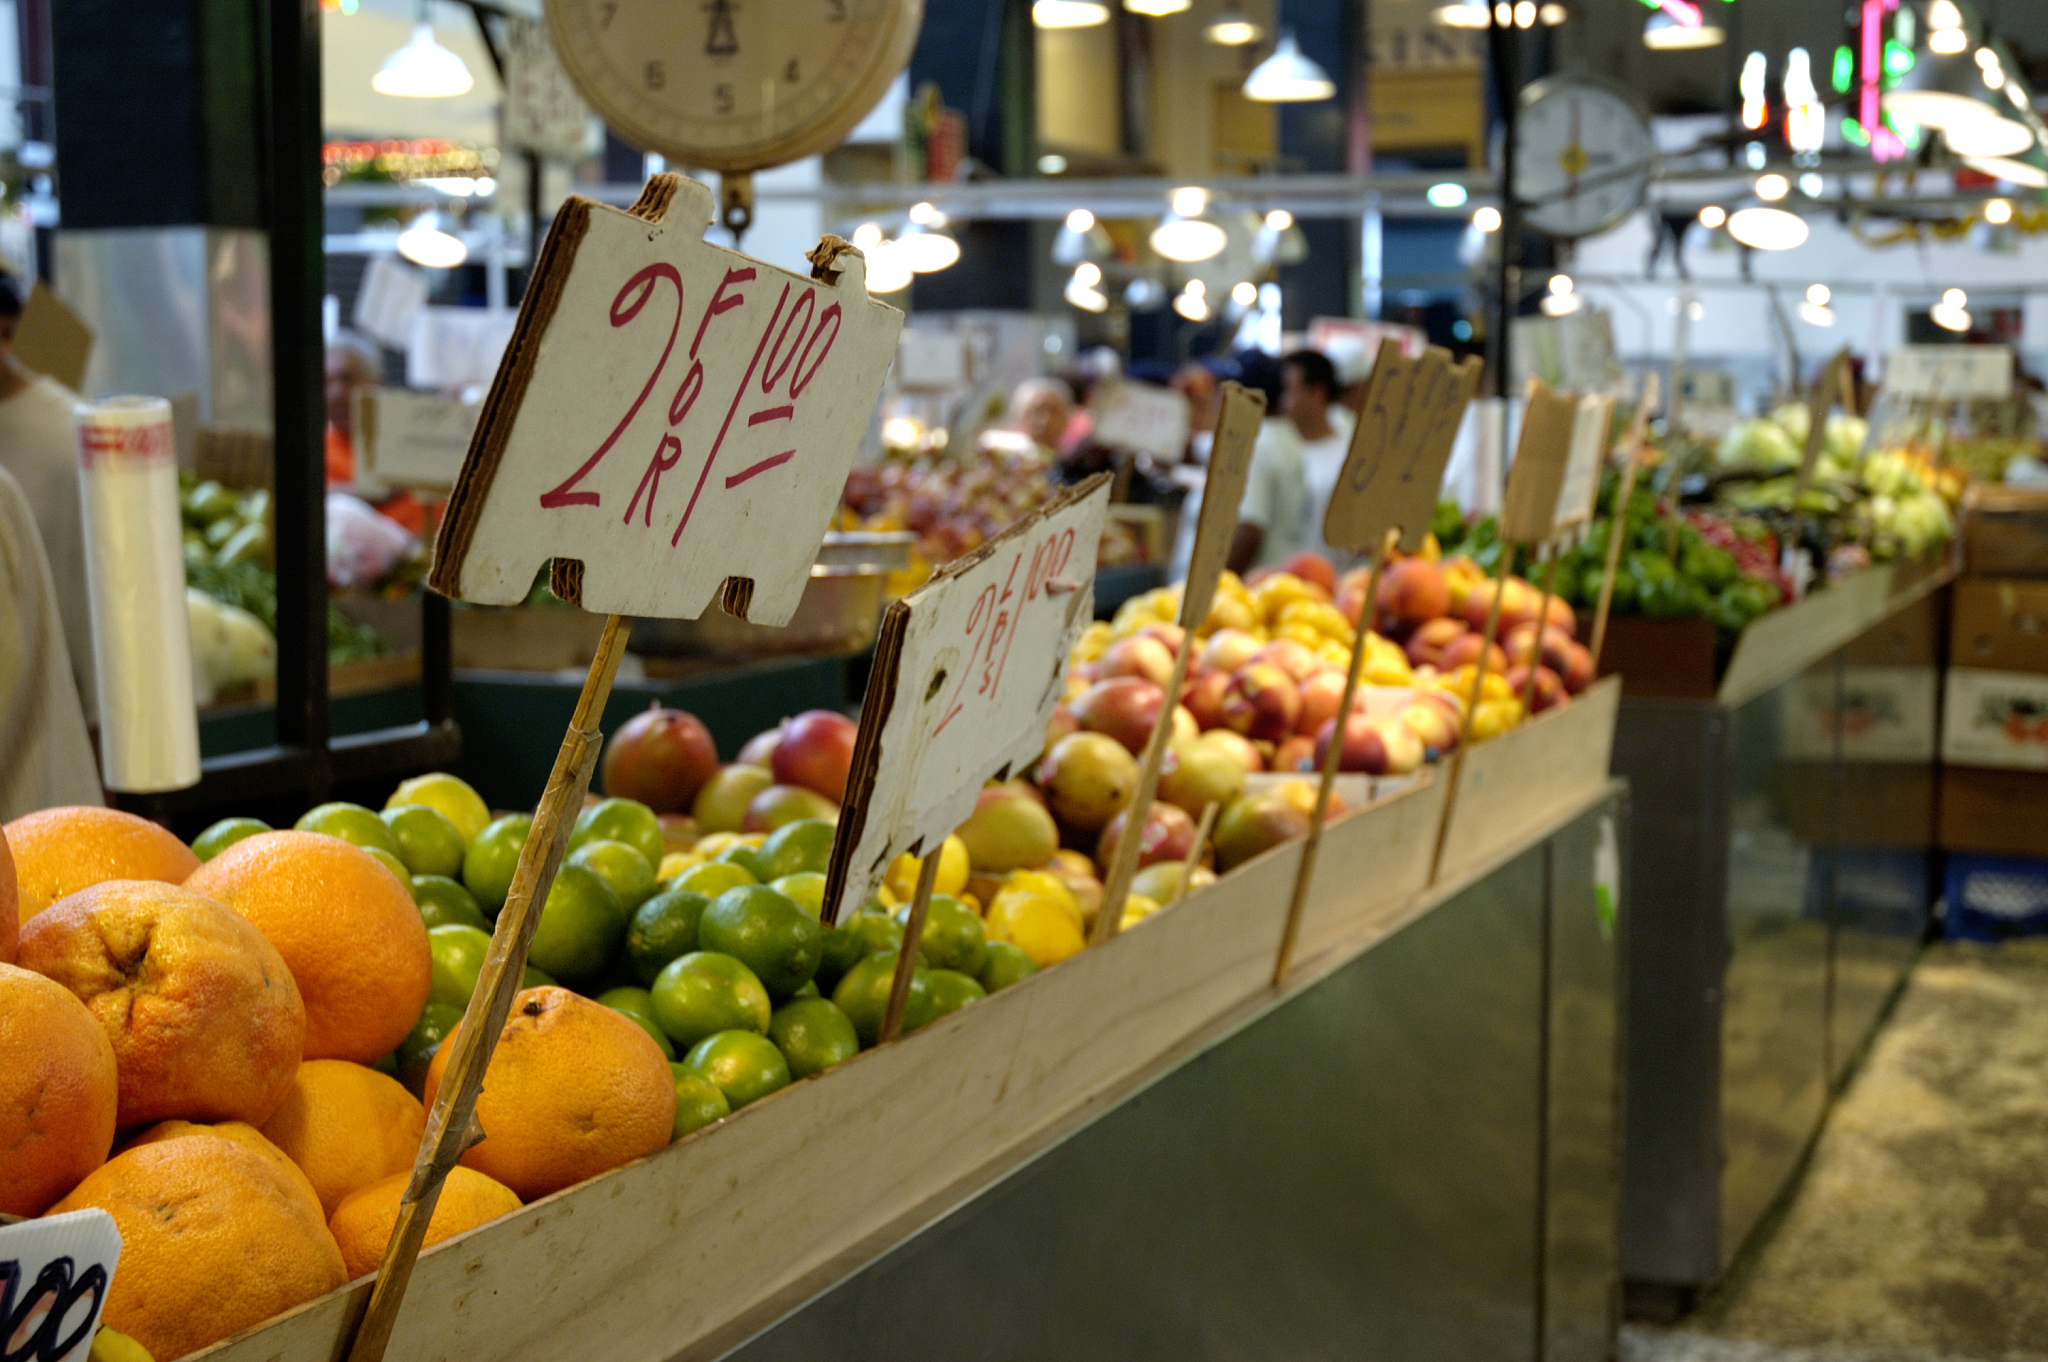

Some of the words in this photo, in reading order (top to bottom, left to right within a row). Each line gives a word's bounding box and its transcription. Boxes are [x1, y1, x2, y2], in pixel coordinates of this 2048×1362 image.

[540, 262, 684, 509] 2
[623, 267, 757, 528] FOR
[933, 582, 996, 738] 2
